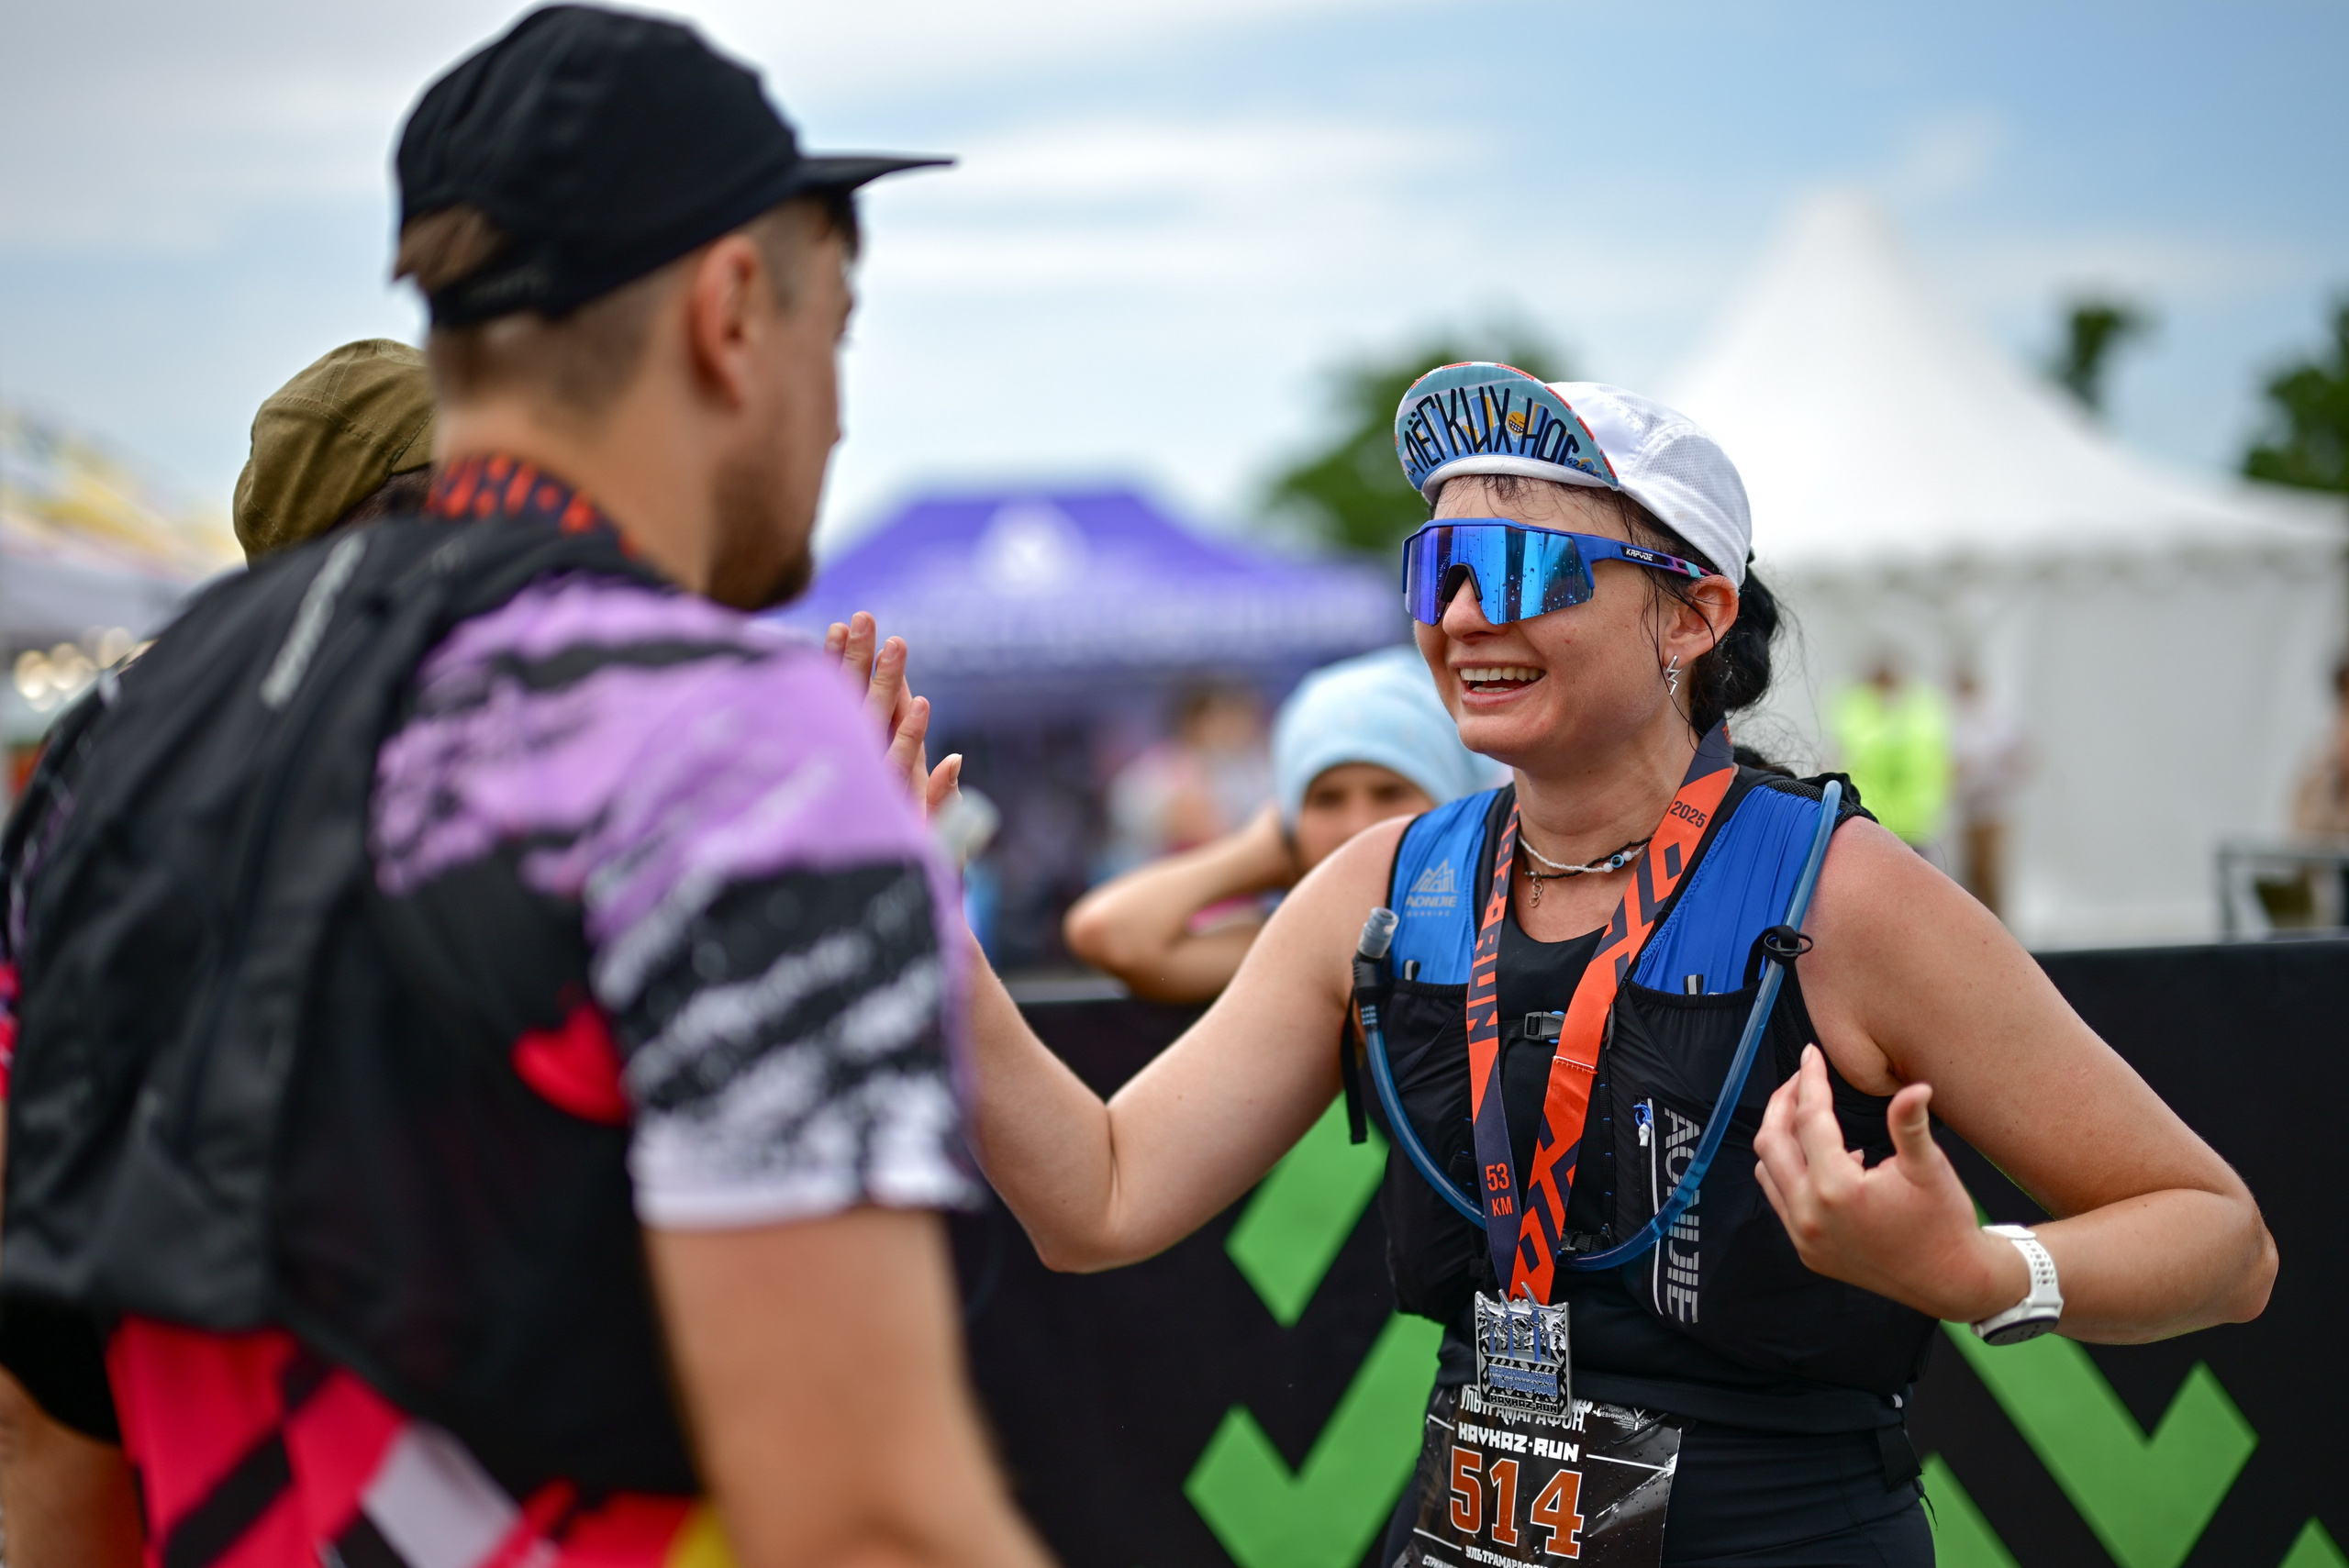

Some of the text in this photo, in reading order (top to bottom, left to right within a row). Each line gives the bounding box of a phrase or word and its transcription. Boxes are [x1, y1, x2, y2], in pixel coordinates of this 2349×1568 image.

[1669, 800, 1708, 828] 2025
[1485, 1162, 1510, 1192] 53
[1491, 1195, 1513, 1218] KM
[1450, 1445, 1585, 1560] 514
